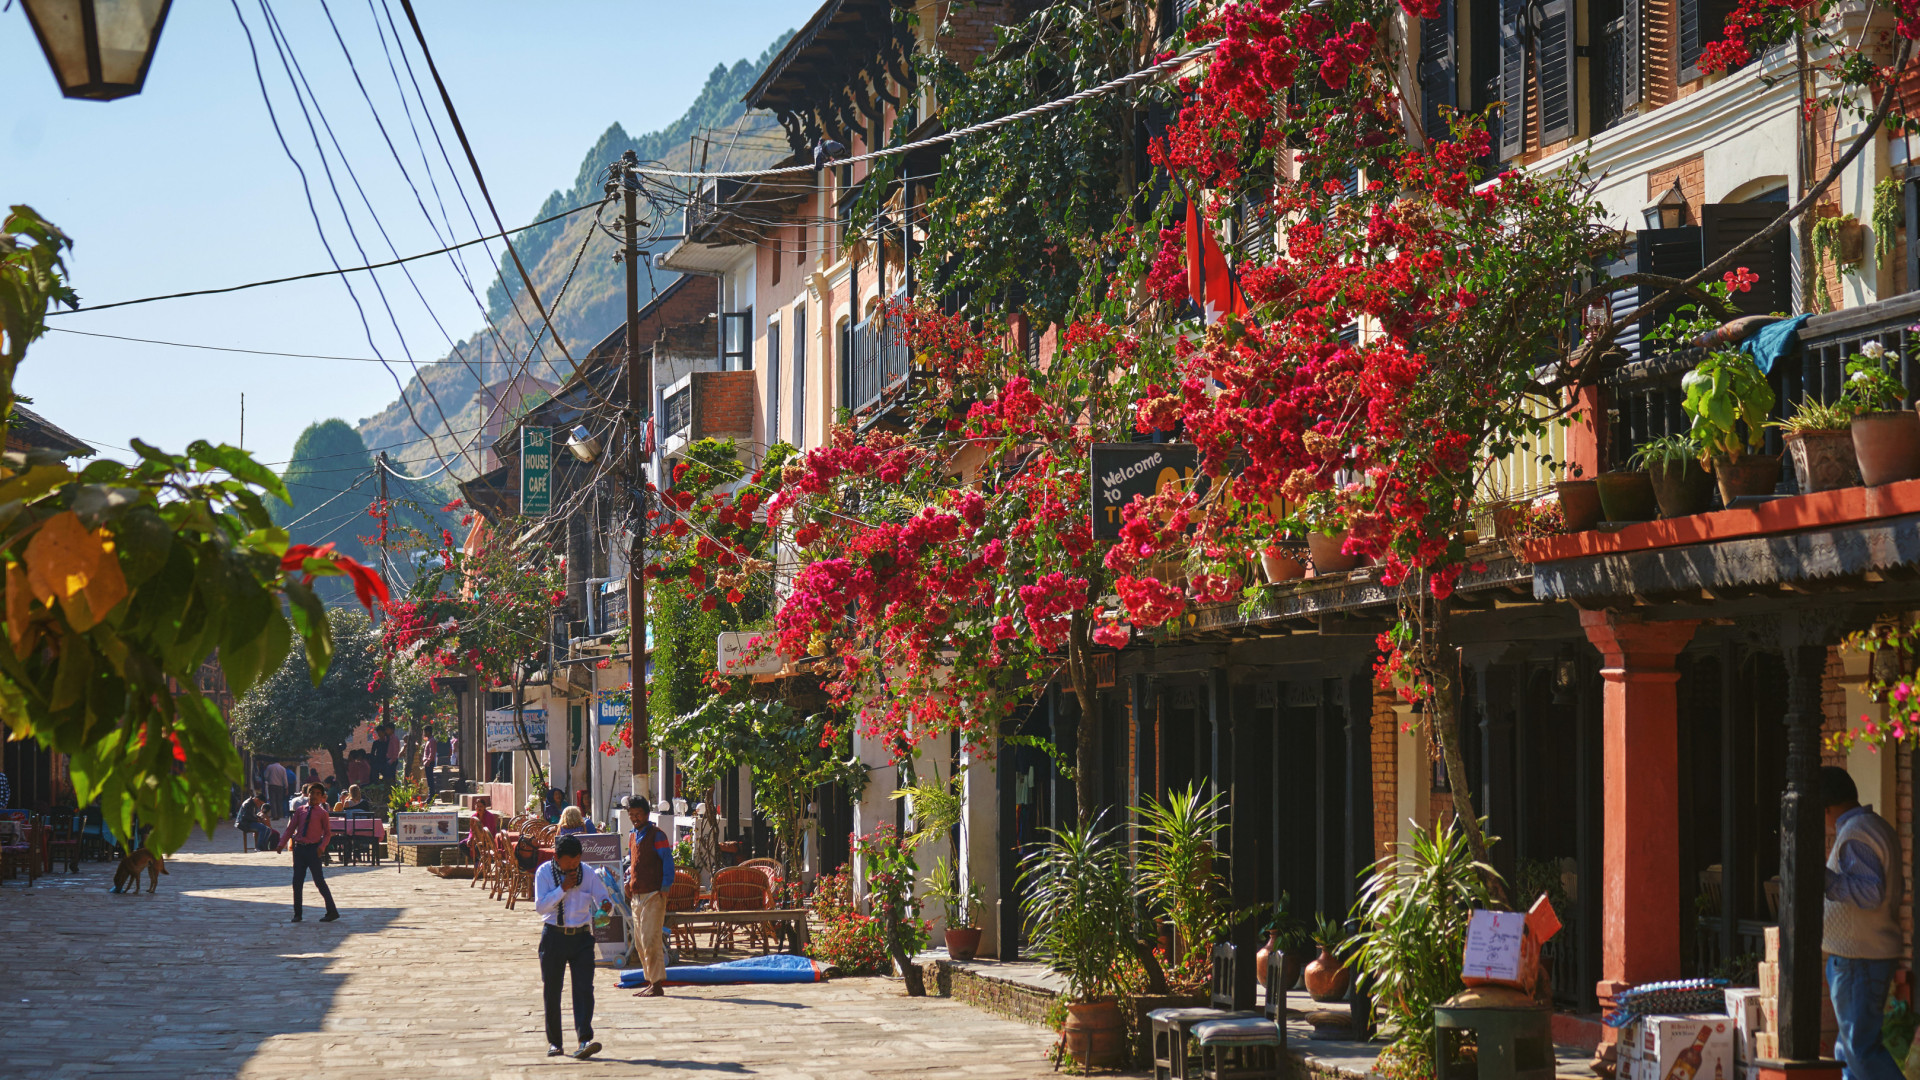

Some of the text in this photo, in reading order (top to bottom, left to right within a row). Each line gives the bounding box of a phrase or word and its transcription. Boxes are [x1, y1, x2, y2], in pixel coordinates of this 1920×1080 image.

[530, 432, 544, 447] OLD
[525, 454, 549, 470] HOUSE
[1102, 452, 1163, 488] Welcome
[1104, 488, 1122, 503] to
